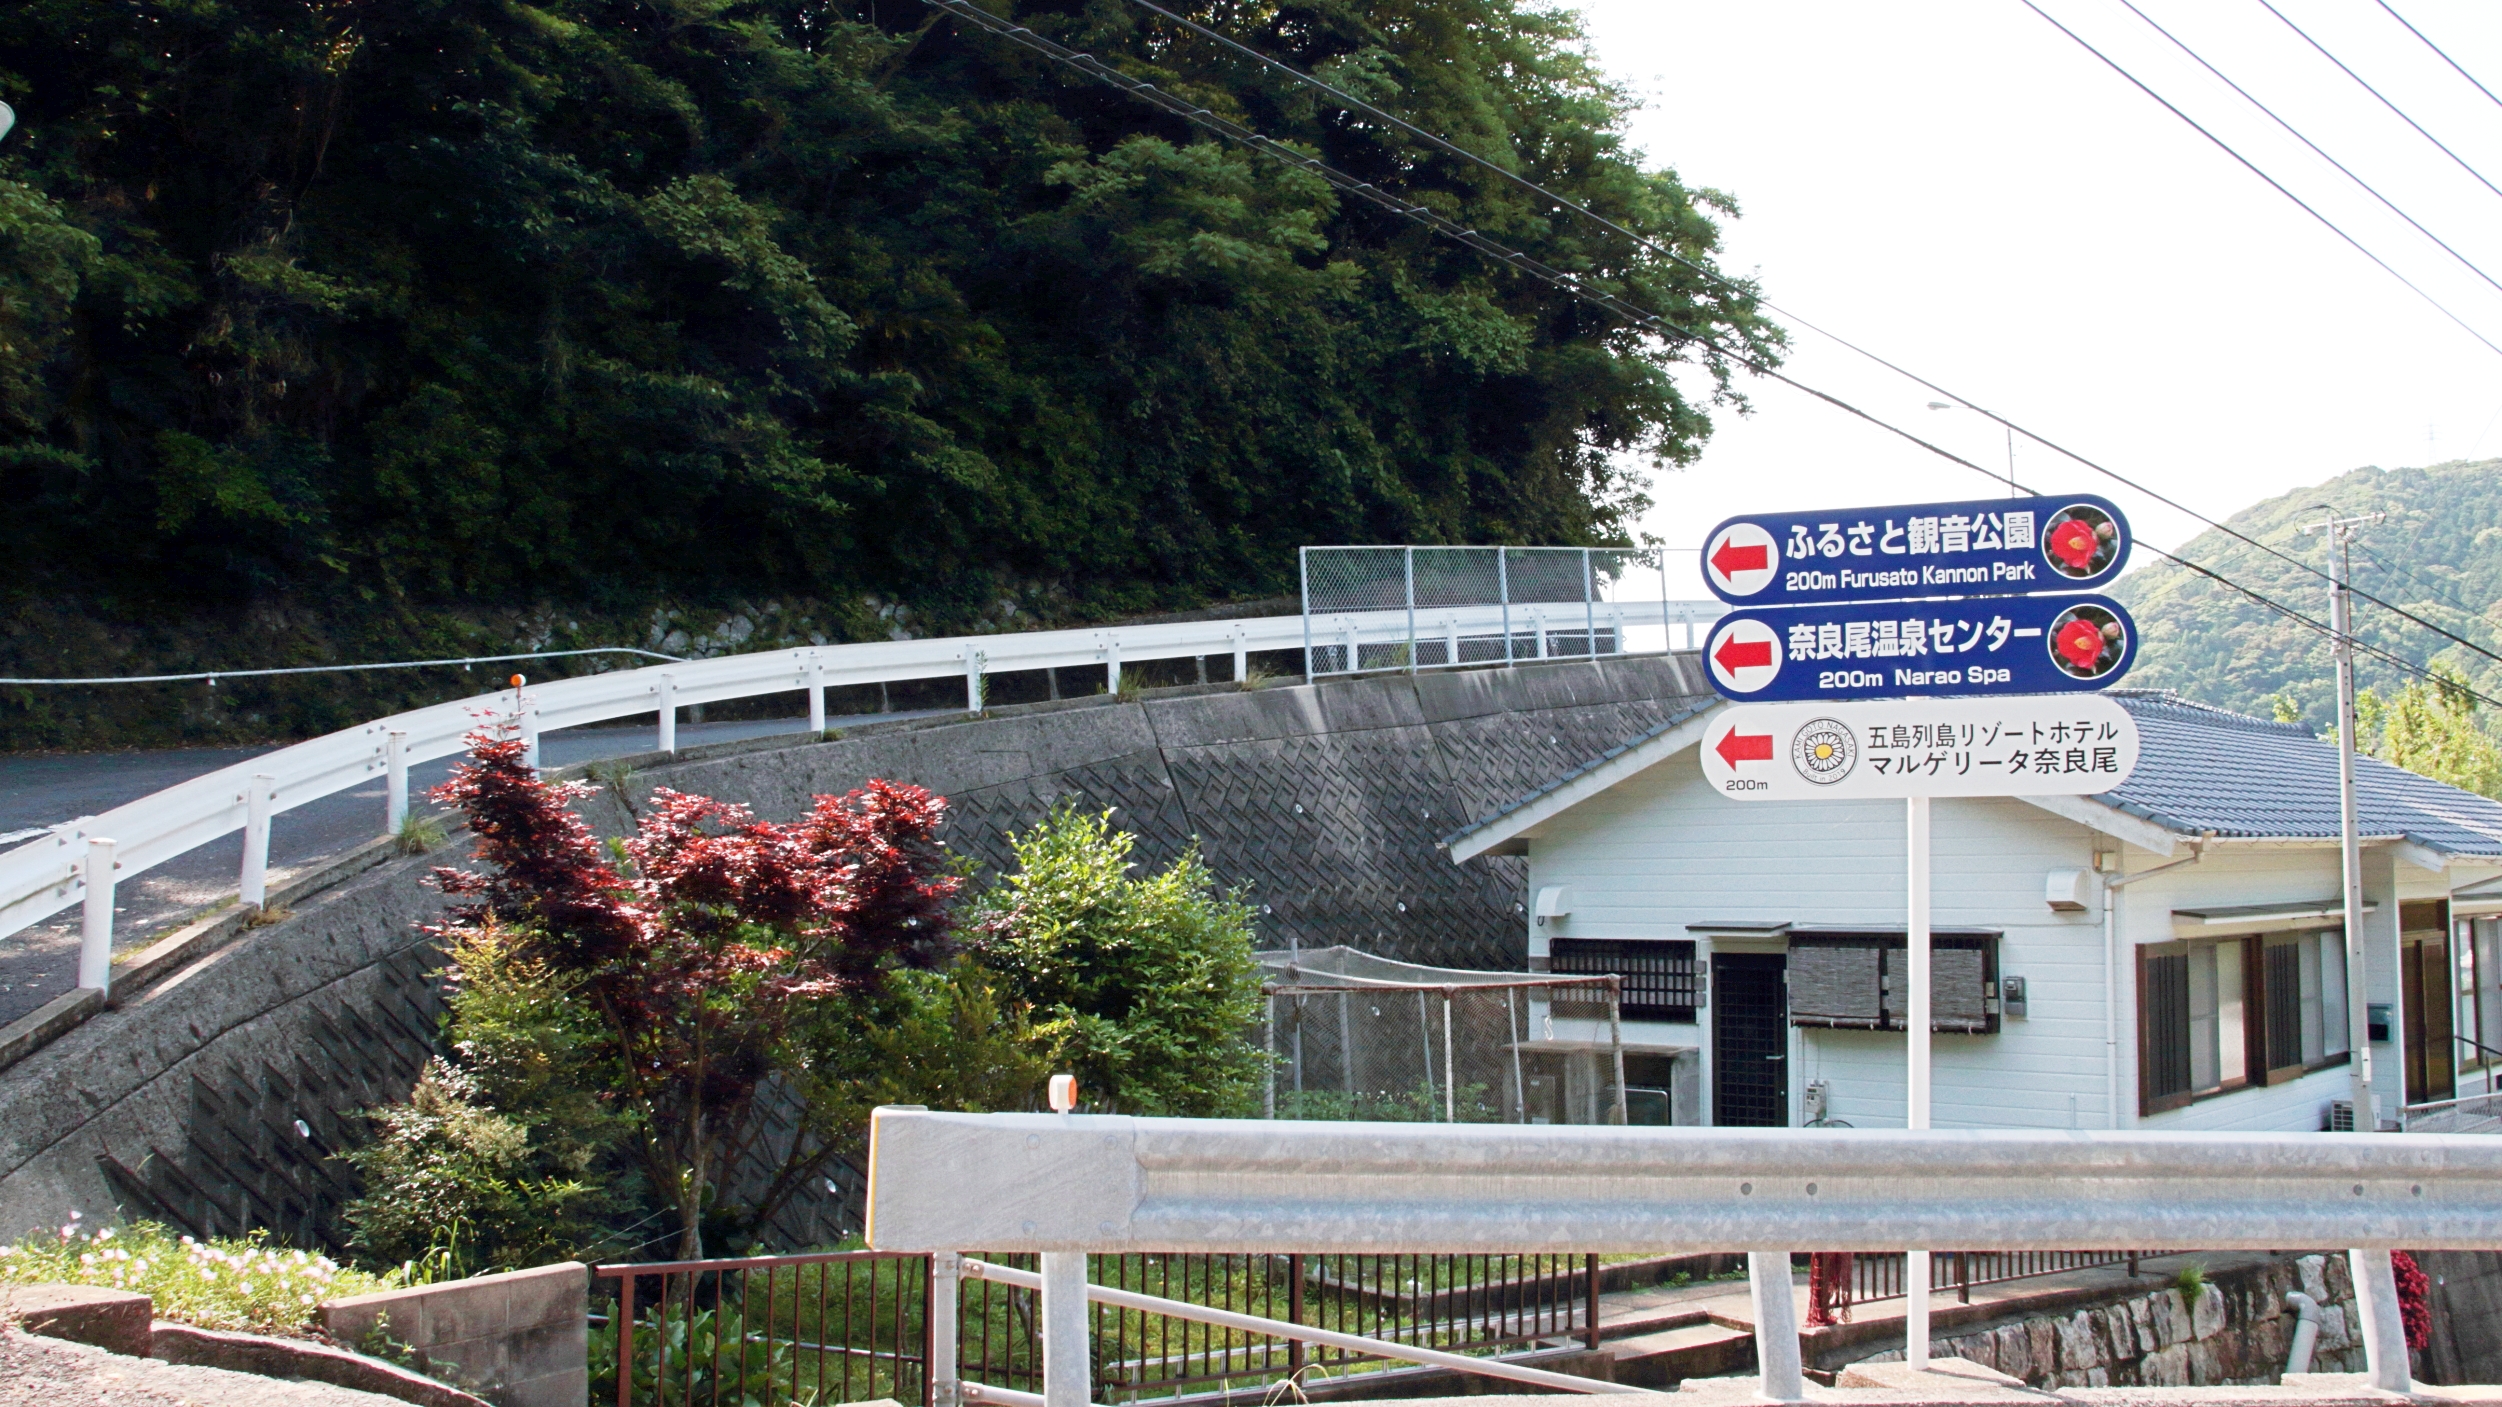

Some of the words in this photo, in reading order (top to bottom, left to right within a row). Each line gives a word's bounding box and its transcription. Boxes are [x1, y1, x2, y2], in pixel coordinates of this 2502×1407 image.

[1786, 511, 2035, 559] ふるさと観音公園
[1786, 571, 1836, 591] 200m
[1841, 568, 1917, 588] Furusato
[1923, 565, 1988, 585] Kannon
[1993, 561, 2035, 581] Park
[1788, 615, 2041, 661] 奈良尾温泉センター
[1819, 671, 1883, 689] 200m
[1895, 668, 1961, 686] Narao
[1968, 666, 2011, 685] Spa
[1794, 738, 1803, 760] KAMI
[1801, 721, 1823, 737] GOTO
[1826, 721, 1855, 758] NAGASAKI
[1867, 719, 2118, 750] 五島列島リゾートホテル
[1802, 768, 1817, 781] Built
[1828, 768, 1846, 782] 2019
[1868, 747, 2118, 775] マルゲリータ奈良尾
[1726, 779, 1768, 791] 200m
